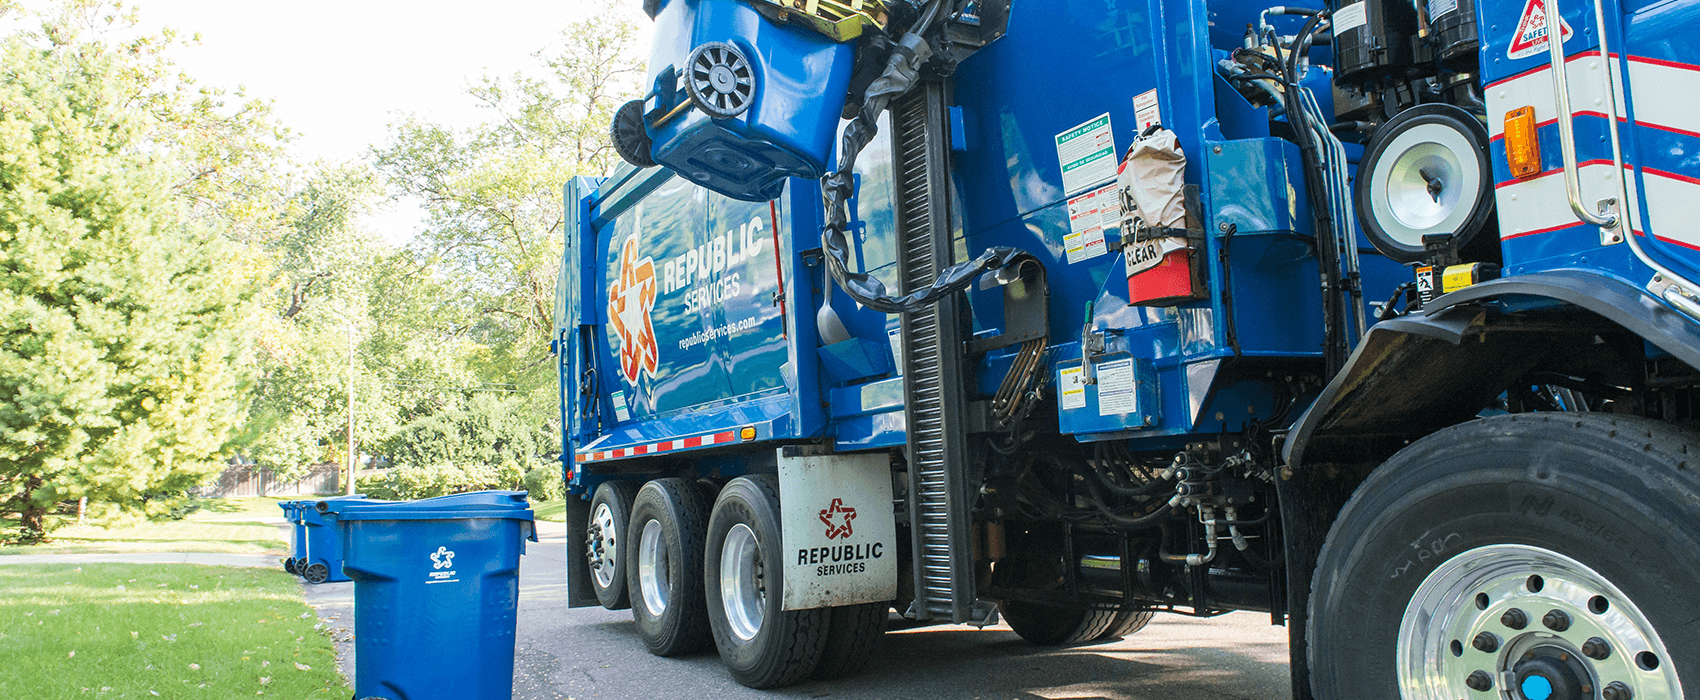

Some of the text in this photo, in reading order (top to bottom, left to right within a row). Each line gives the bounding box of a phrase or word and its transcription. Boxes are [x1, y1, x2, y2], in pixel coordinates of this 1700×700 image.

[1523, 27, 1548, 42] SAFET
[1082, 120, 1104, 133] NOTICE
[664, 216, 763, 295] REPUBLIC
[1126, 244, 1157, 267] CLEAR
[684, 272, 740, 315] SERVICES
[678, 316, 756, 350] republicservices.com
[797, 542, 883, 565] REPUBLIC
[817, 562, 865, 576] SERVICES
